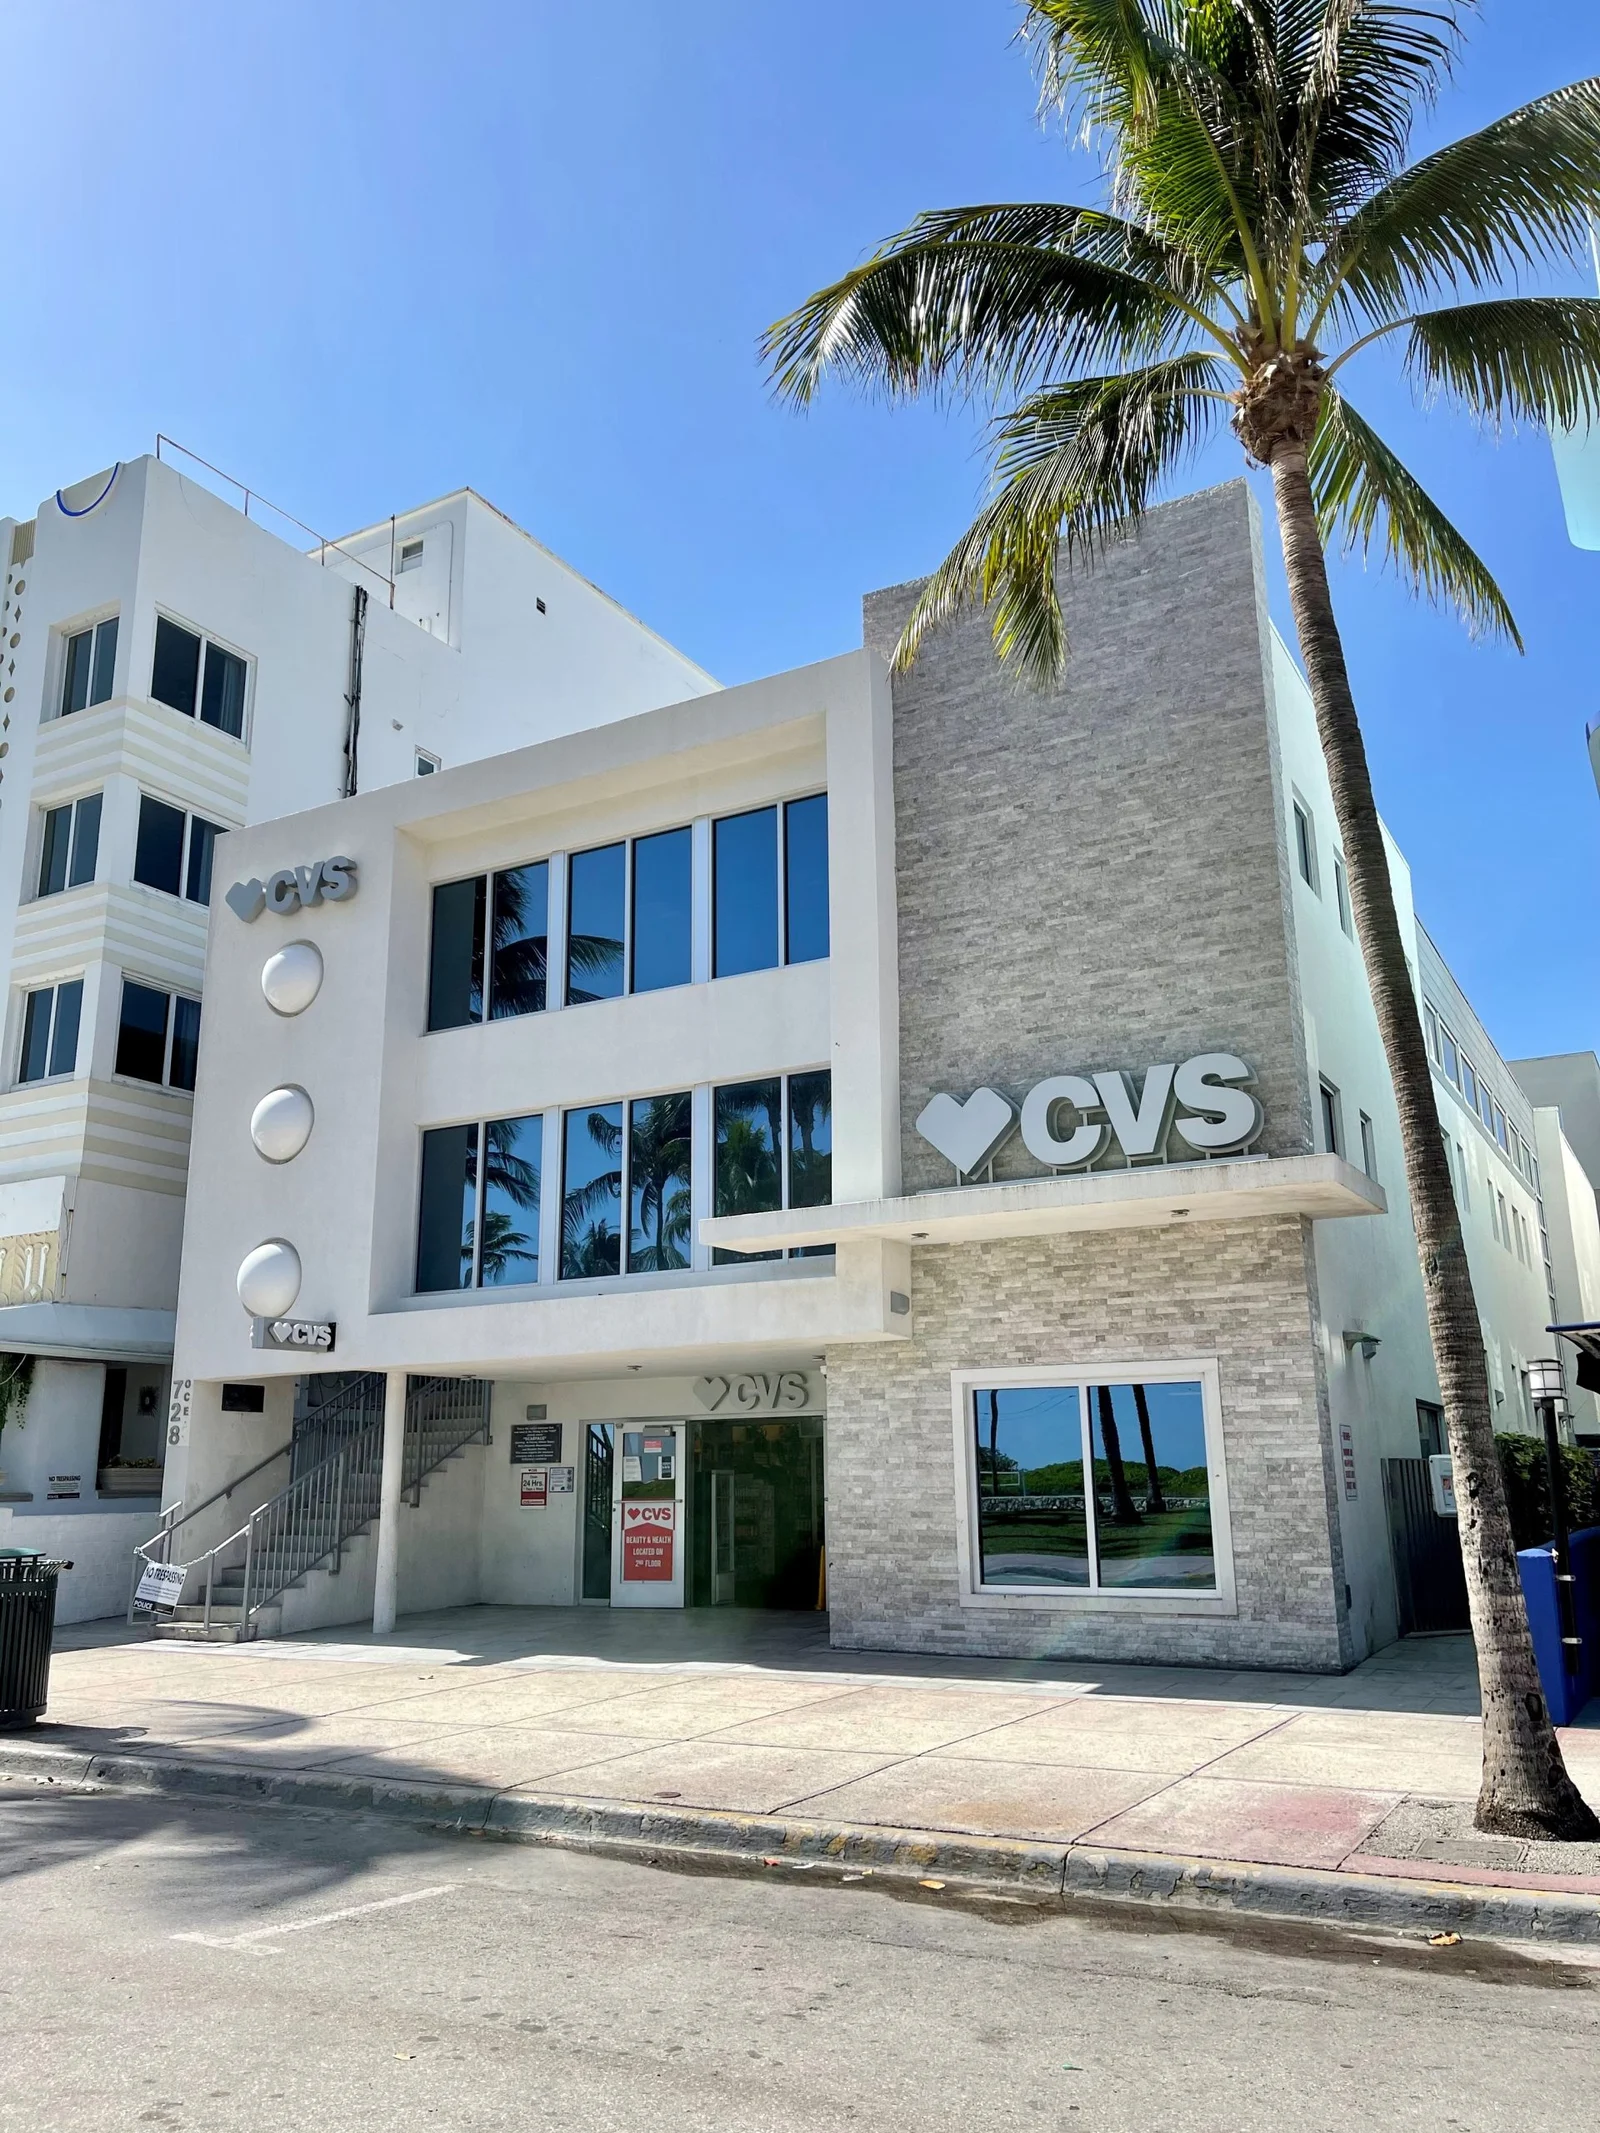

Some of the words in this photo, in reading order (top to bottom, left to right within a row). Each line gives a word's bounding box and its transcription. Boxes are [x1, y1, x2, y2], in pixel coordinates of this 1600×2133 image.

[265, 855, 357, 916] CVS
[1021, 1053, 1262, 1168] CVS
[292, 1323, 332, 1346] CVS
[729, 1372, 808, 1411] CVS
[641, 1508, 672, 1521] CVS
[626, 1536, 646, 1544] BEAUTY
[647, 1536, 652, 1544] &
[652, 1536, 672, 1544] HEALTH
[633, 1548, 655, 1556] LOCATED
[656, 1548, 664, 1556] ON
[645, 1560, 662, 1568] FLOOR
[144, 1566, 155, 1579] NO
[154, 1567, 186, 1585] TRESPASSING
[133, 1600, 154, 1610] POLICE
